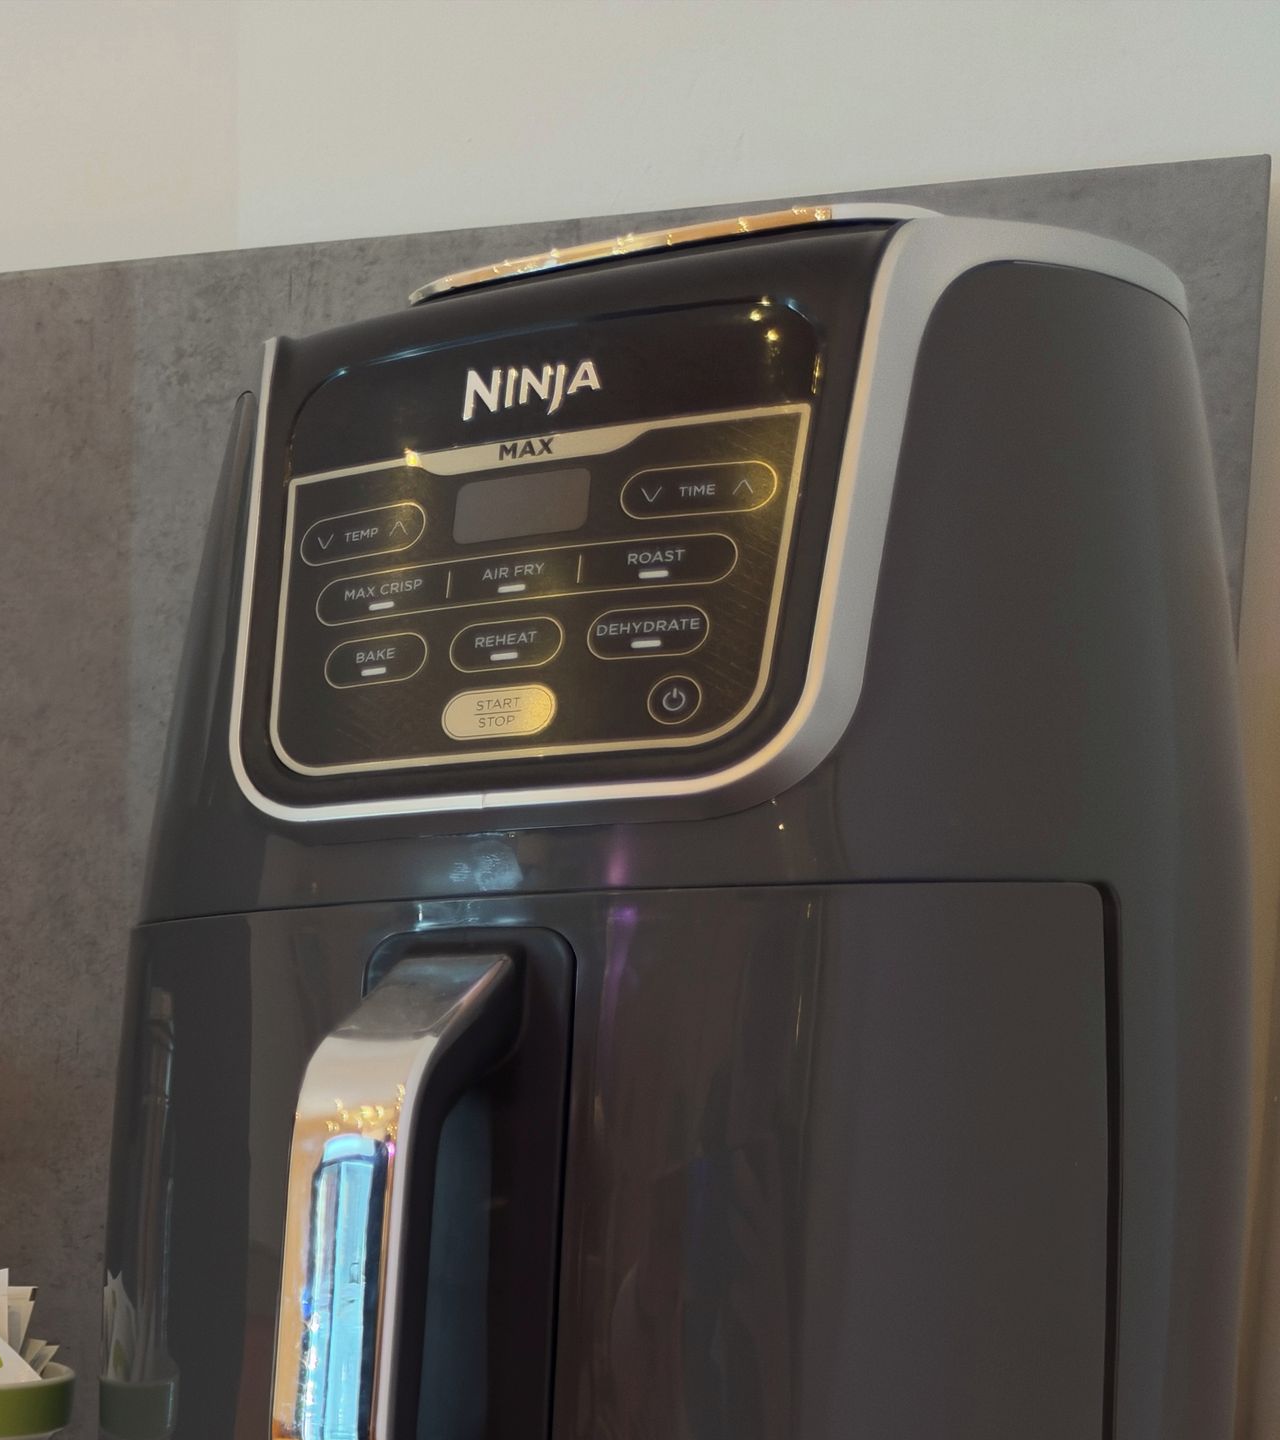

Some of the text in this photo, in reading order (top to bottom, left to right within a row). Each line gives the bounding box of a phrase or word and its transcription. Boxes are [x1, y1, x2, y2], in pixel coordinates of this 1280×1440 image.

[462, 361, 602, 422] NINJA
[498, 437, 555, 461] MAX
[679, 484, 716, 497] TIME
[343, 527, 379, 543] TEMP
[627, 549, 686, 566] ROAST
[482, 562, 545, 581] AIR FRY
[344, 578, 423, 602] MAX CRISP
[596, 617, 701, 637] DEHYDRATE
[474, 631, 538, 649] REHEAT
[356, 647, 397, 664] BAKE
[475, 696, 521, 711] START
[478, 715, 516, 729] STOP
